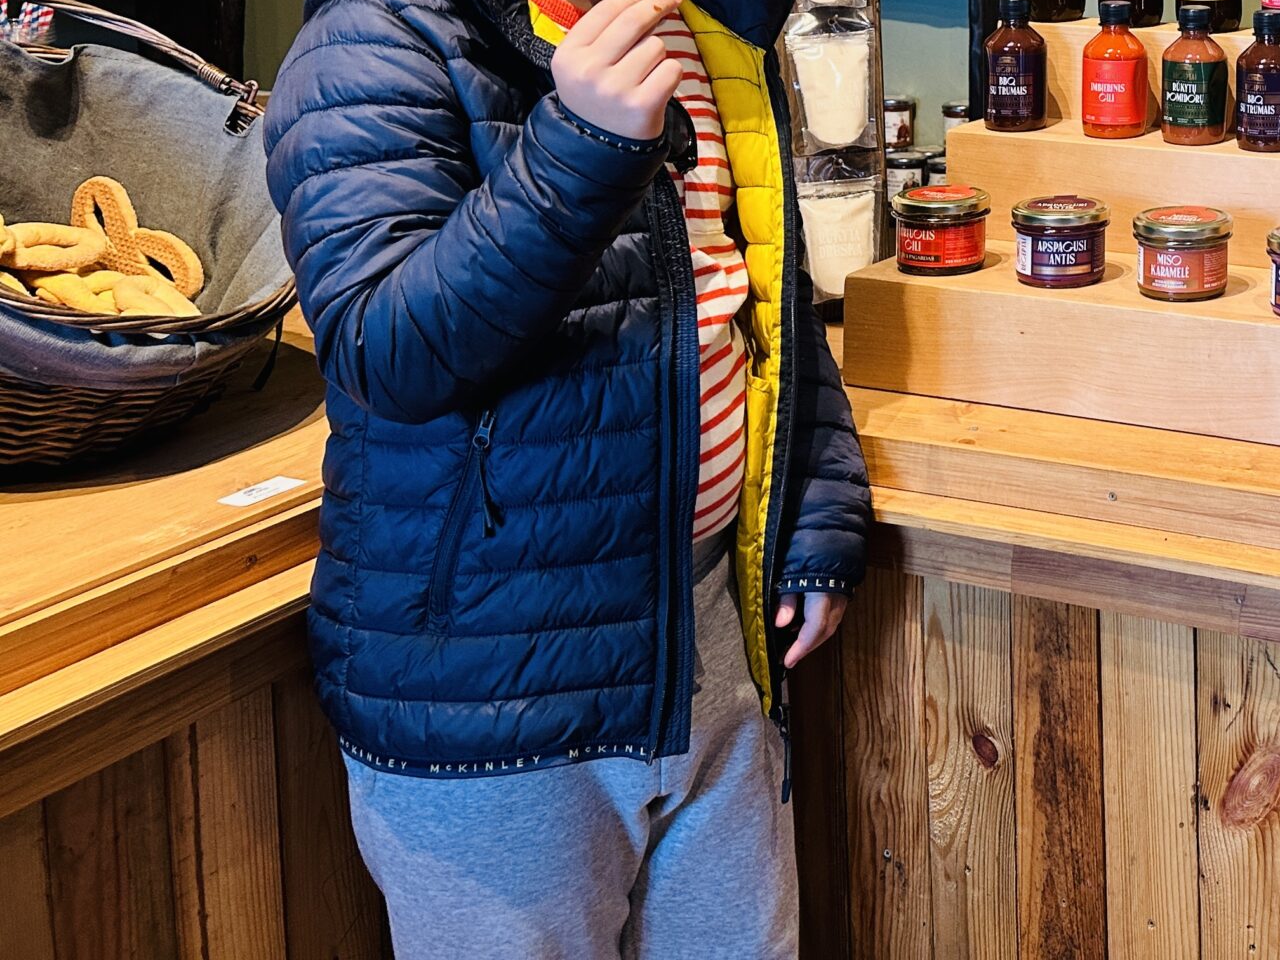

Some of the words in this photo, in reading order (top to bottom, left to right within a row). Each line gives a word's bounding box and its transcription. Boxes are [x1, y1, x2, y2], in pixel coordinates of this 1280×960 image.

[998, 76, 1015, 86] BBQ
[998, 86, 1027, 96] TRUMAIS
[1166, 91, 1204, 105] POMIDORŲ
[1247, 94, 1264, 104] BBQ
[1247, 104, 1275, 115] TRUMAIS
[1037, 240, 1087, 252] APSPAGUSI
[1048, 253, 1075, 265] ANTIS
[1156, 253, 1182, 266] MISO
[1150, 263, 1190, 279] KARAMELĖ
[568, 744, 647, 759] McKINL
